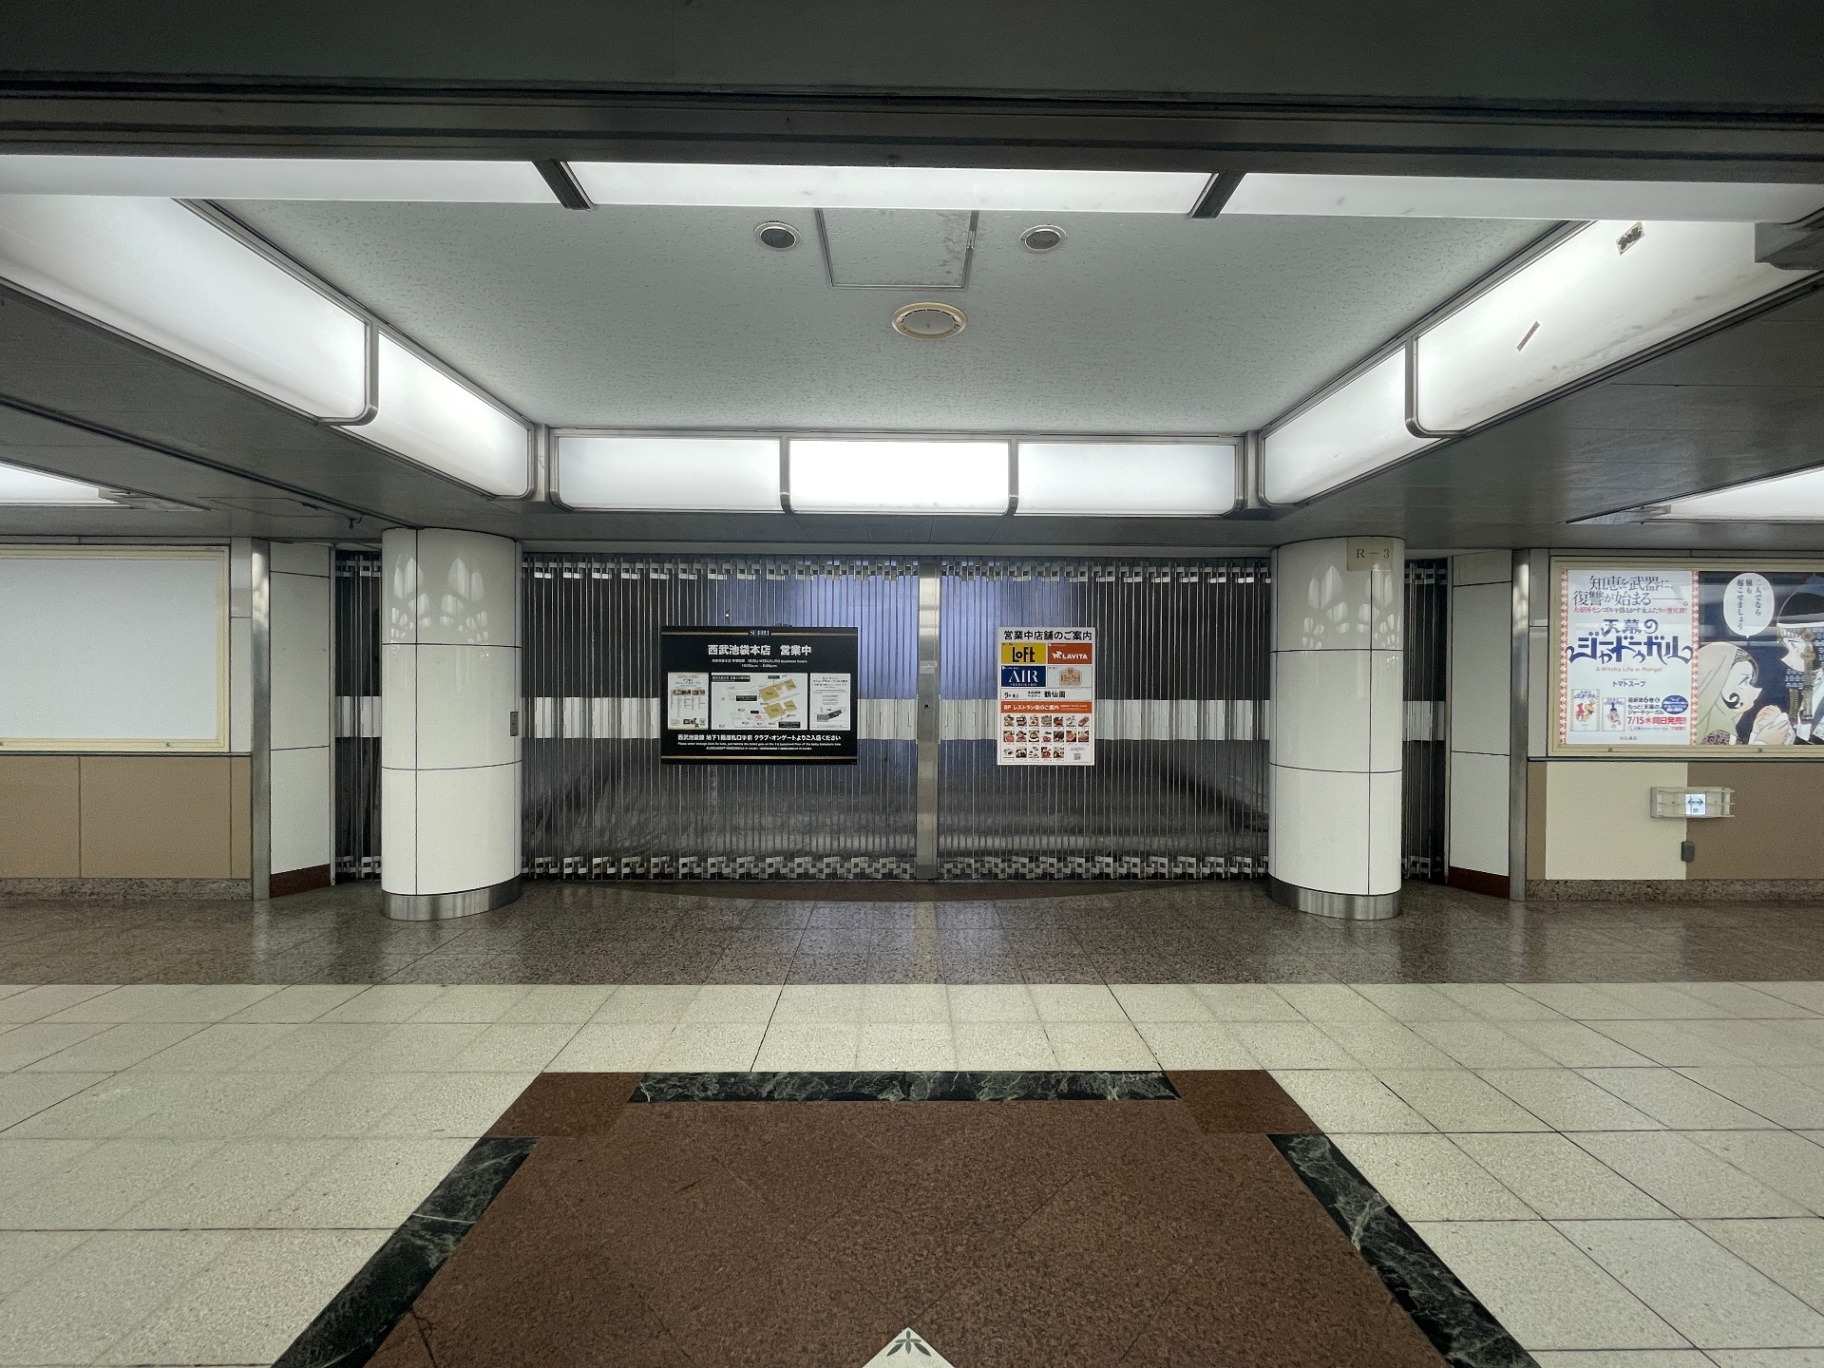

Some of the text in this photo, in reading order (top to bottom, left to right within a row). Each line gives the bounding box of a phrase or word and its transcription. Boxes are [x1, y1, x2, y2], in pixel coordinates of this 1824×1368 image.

[1600, 618, 1659, 637] 天幕の
[1003, 630, 1092, 641] 営業中店舗のご案内
[707, 644, 812, 656] 西武池袋本店 営業中
[1008, 669, 1039, 683] AIR
[1612, 680, 1646, 688] トマトスープ
